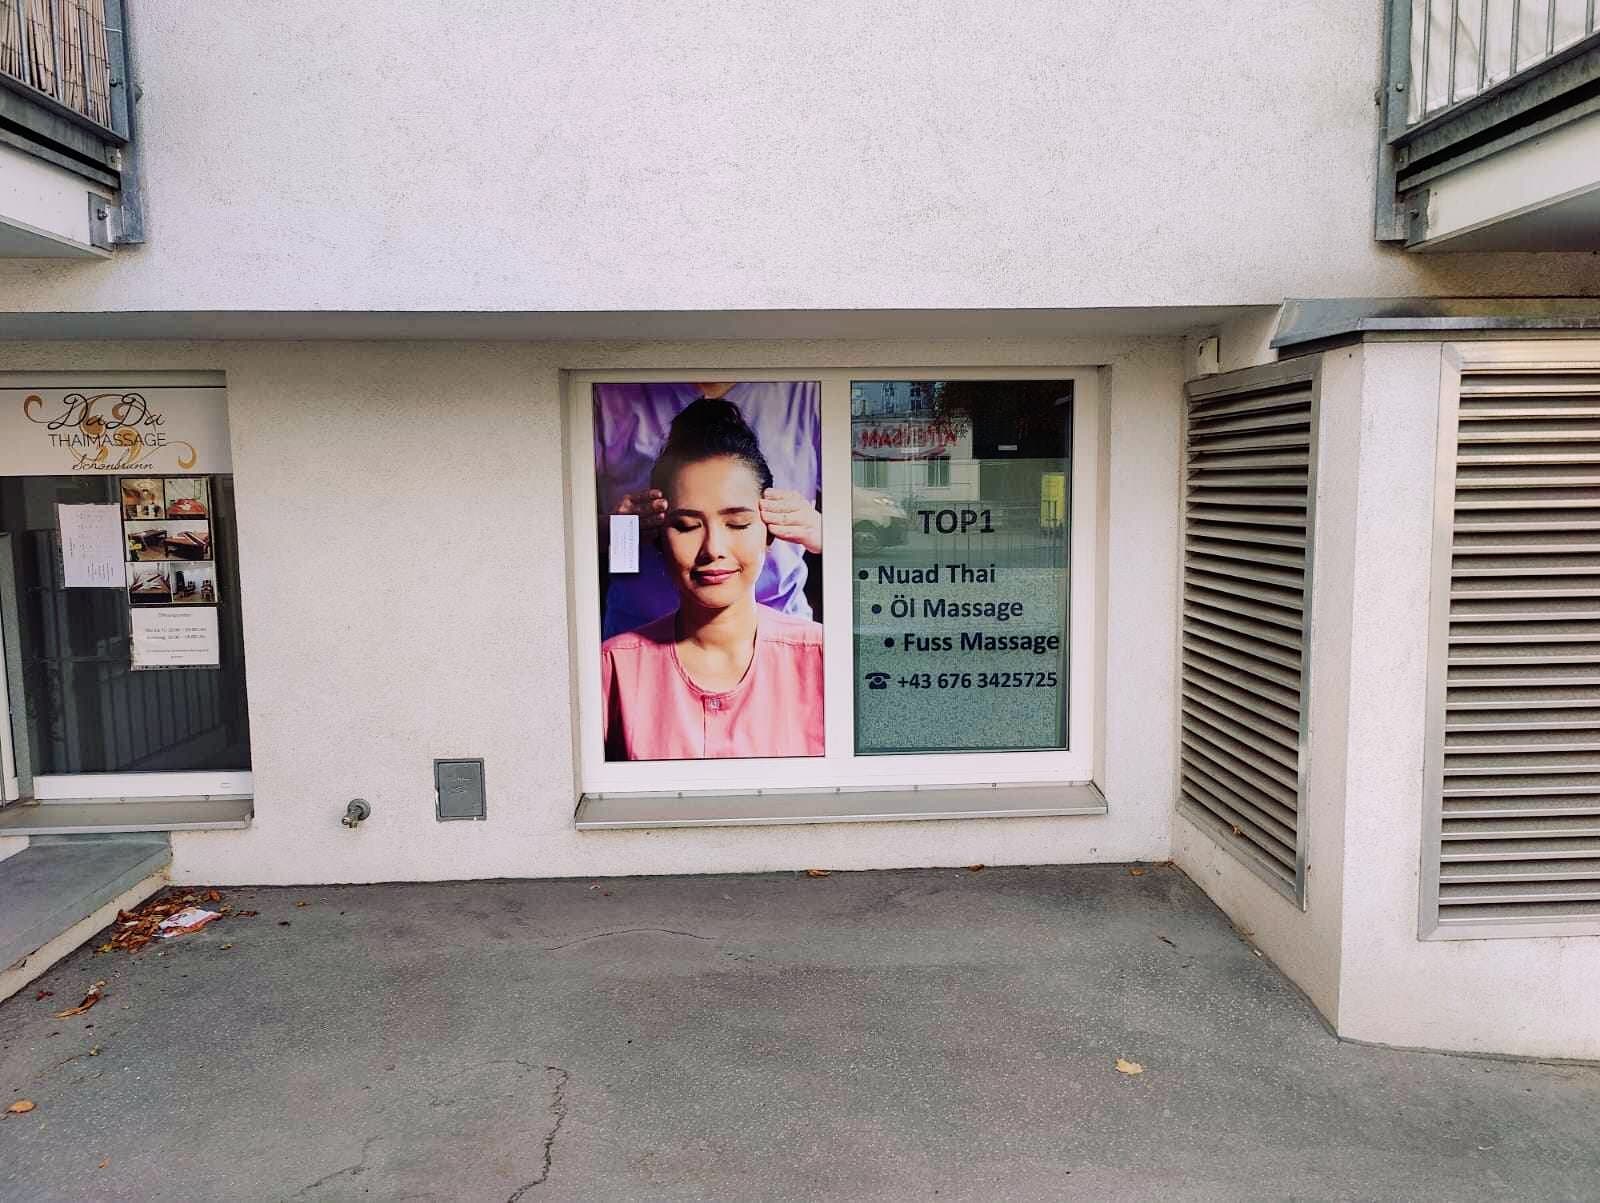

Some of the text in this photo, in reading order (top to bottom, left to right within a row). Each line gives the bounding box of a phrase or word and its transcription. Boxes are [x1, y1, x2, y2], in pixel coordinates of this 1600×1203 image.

[48, 432, 167, 448] THAIMASSAGE
[918, 509, 995, 534] TOP1
[878, 563, 995, 584] Nuad Thai
[890, 594, 1023, 621] Öl Massage
[903, 632, 1060, 654] Fuss Massage
[897, 671, 1058, 689] +43 676 3425725
